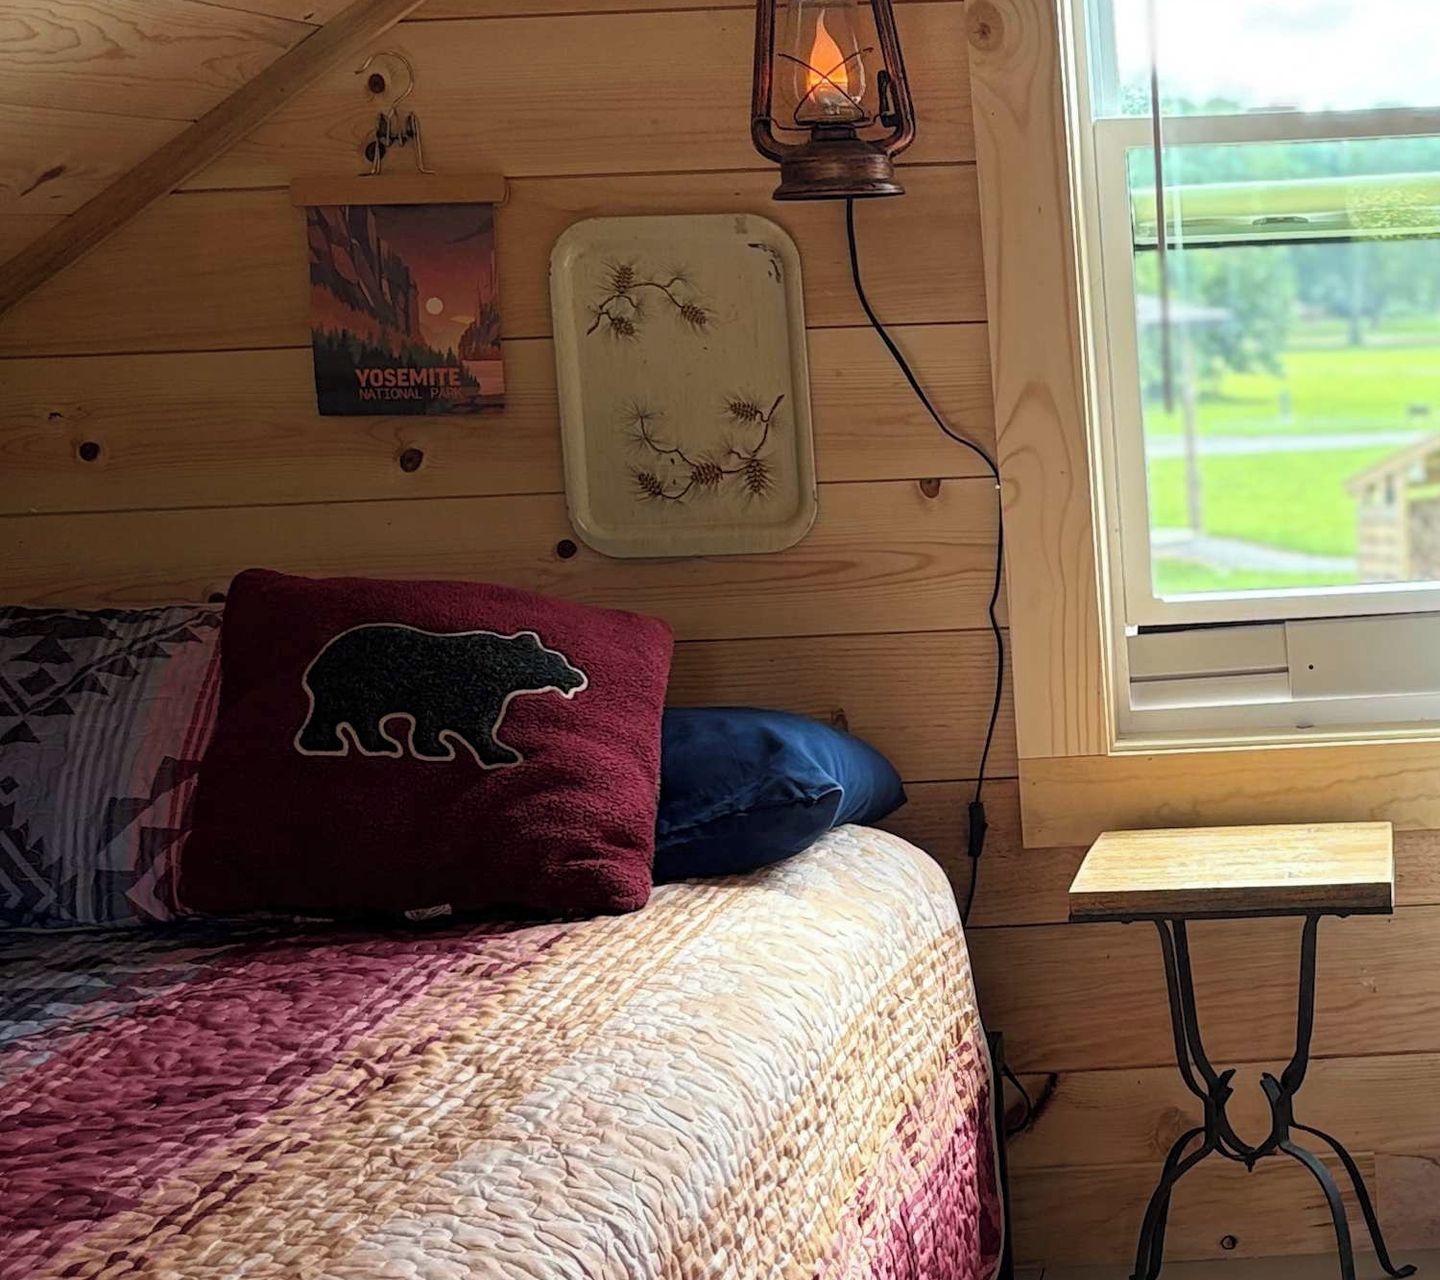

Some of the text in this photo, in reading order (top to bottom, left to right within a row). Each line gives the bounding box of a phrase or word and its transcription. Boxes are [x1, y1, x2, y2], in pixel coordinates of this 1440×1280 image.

[355, 367, 461, 387] YOSEMITE
[359, 387, 463, 400] NATIONAL PARK
